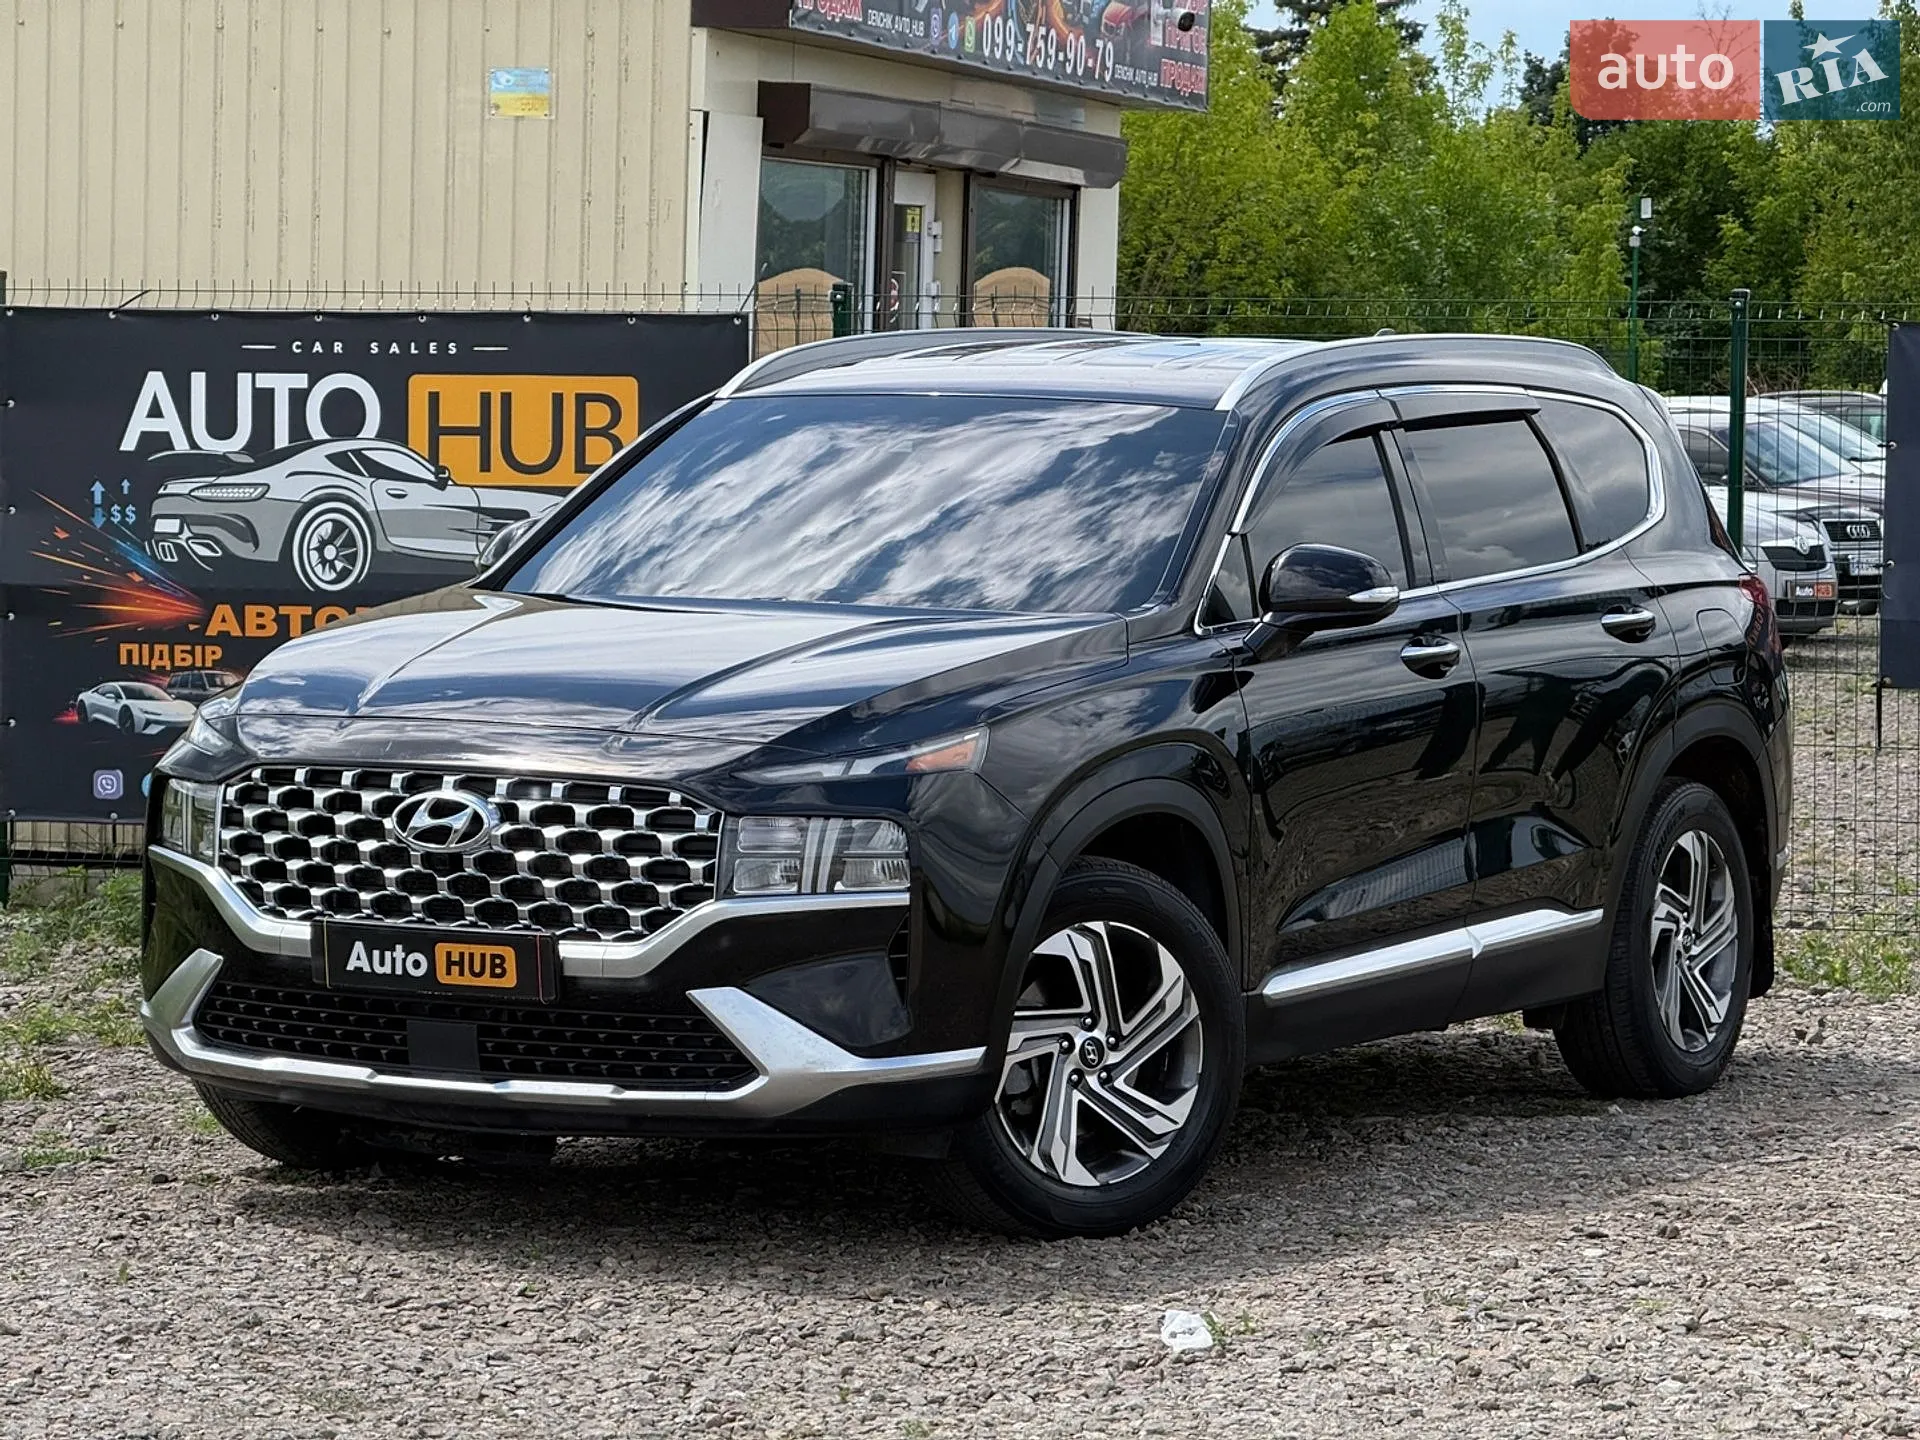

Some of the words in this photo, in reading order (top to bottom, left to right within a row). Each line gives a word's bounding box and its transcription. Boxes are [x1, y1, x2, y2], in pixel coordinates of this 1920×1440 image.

[982, 13, 1114, 82] 099-759-90-79
[292, 341, 344, 354] CAR
[369, 342, 458, 355] SALES
[119, 370, 382, 453] AUTO
[428, 390, 625, 475] HUB
[205, 603, 372, 639] АВТО
[119, 642, 223, 671] ПІДБІР
[346, 940, 428, 978] Auto
[445, 950, 508, 979] HUB
